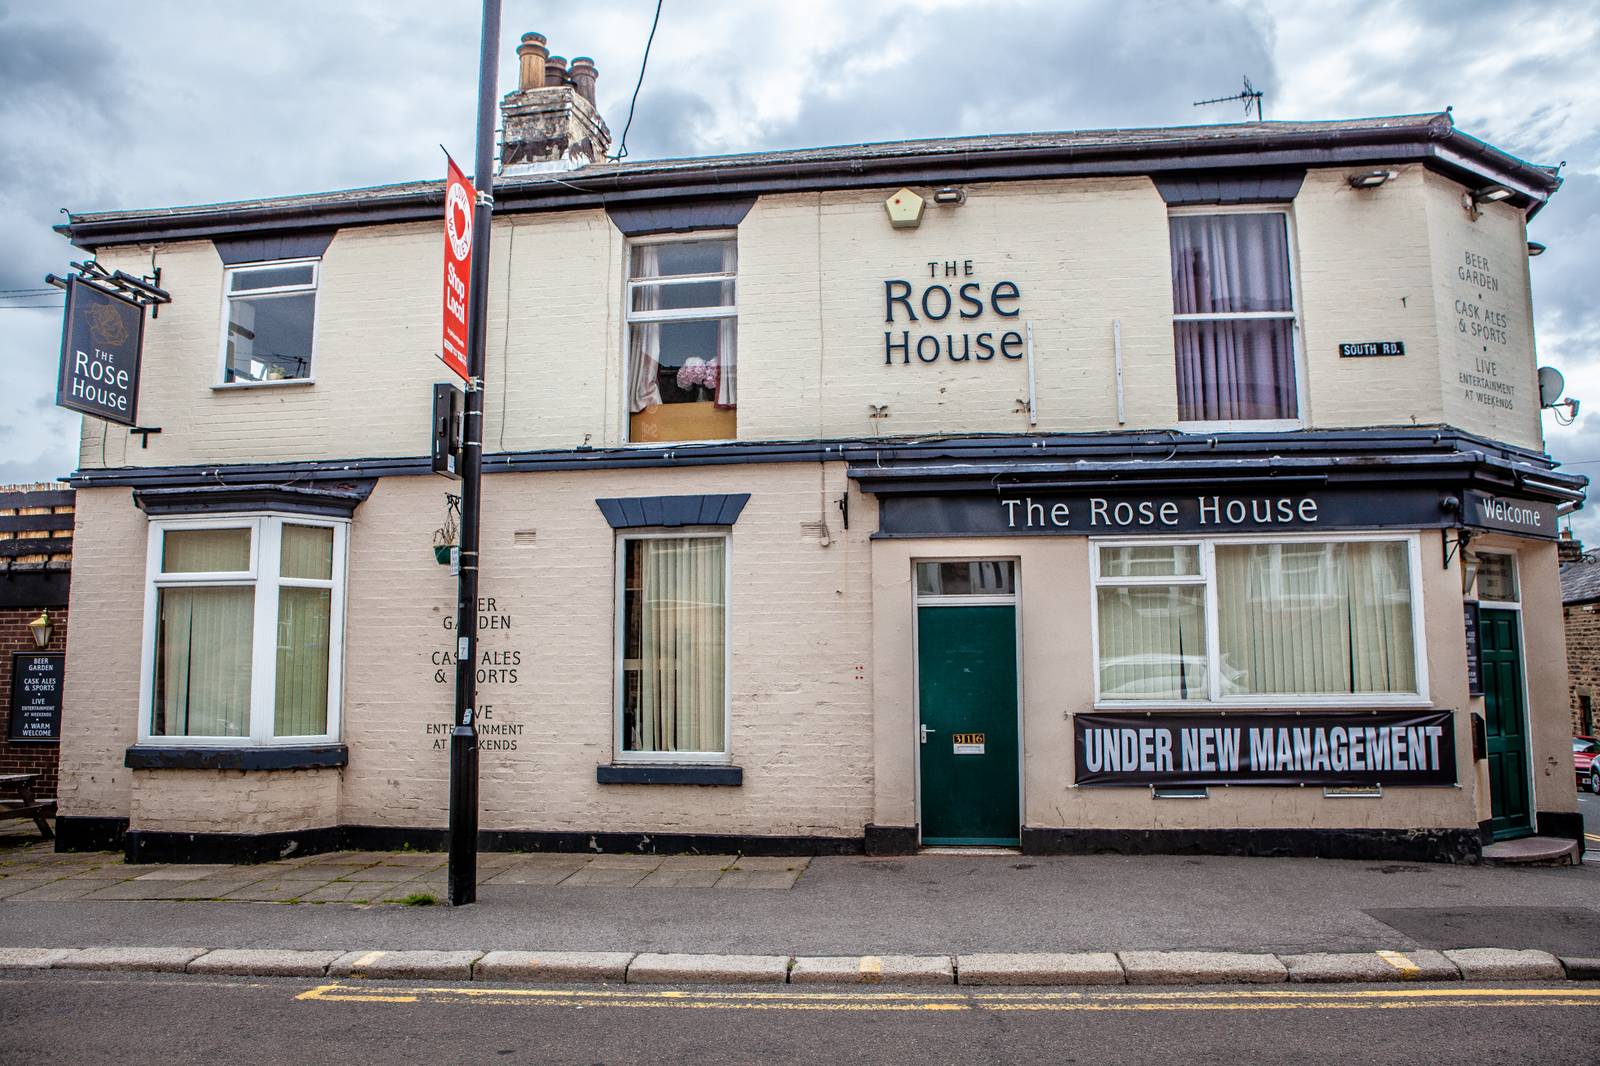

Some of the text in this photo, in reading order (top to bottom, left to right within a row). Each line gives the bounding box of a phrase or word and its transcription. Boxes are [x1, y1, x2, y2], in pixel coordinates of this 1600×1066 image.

[927, 260, 973, 278] THE
[1464, 251, 1490, 272] BEER
[448, 261, 464, 303] Shop
[1458, 266, 1498, 292] GARDEN
[447, 286, 465, 325] Local
[884, 279, 1020, 322] Rose
[1455, 299, 1507, 328] CASK ALES
[1458, 319, 1507, 345] & SPORTS
[95, 349, 114, 363] THE
[884, 330, 1024, 365] House
[1343, 342, 1401, 356] SOUTH RD.
[74, 350, 129, 390] Rose
[1475, 358, 1497, 377] LIVE
[72, 377, 127, 411] House
[1459, 372, 1515, 396] ENTERTAINMENT
[1464, 388, 1513, 410] AT WEEKENDS
[1002, 495, 1318, 528] The Rose House
[1483, 498, 1541, 527] Welcome
[478, 597, 497, 612] ER
[443, 615, 511, 630] GDEN
[33, 657, 49, 665] BEER
[431, 651, 521, 666] CAS ALES
[434, 669, 518, 684] & ORTS
[475, 705, 493, 719] VE
[426, 724, 525, 735] ENTEINMENT
[954, 734, 984, 744] 316
[432, 739, 518, 751] AT KENDS
[1085, 726, 1443, 772] UNDER NEW MANAGEMENT
